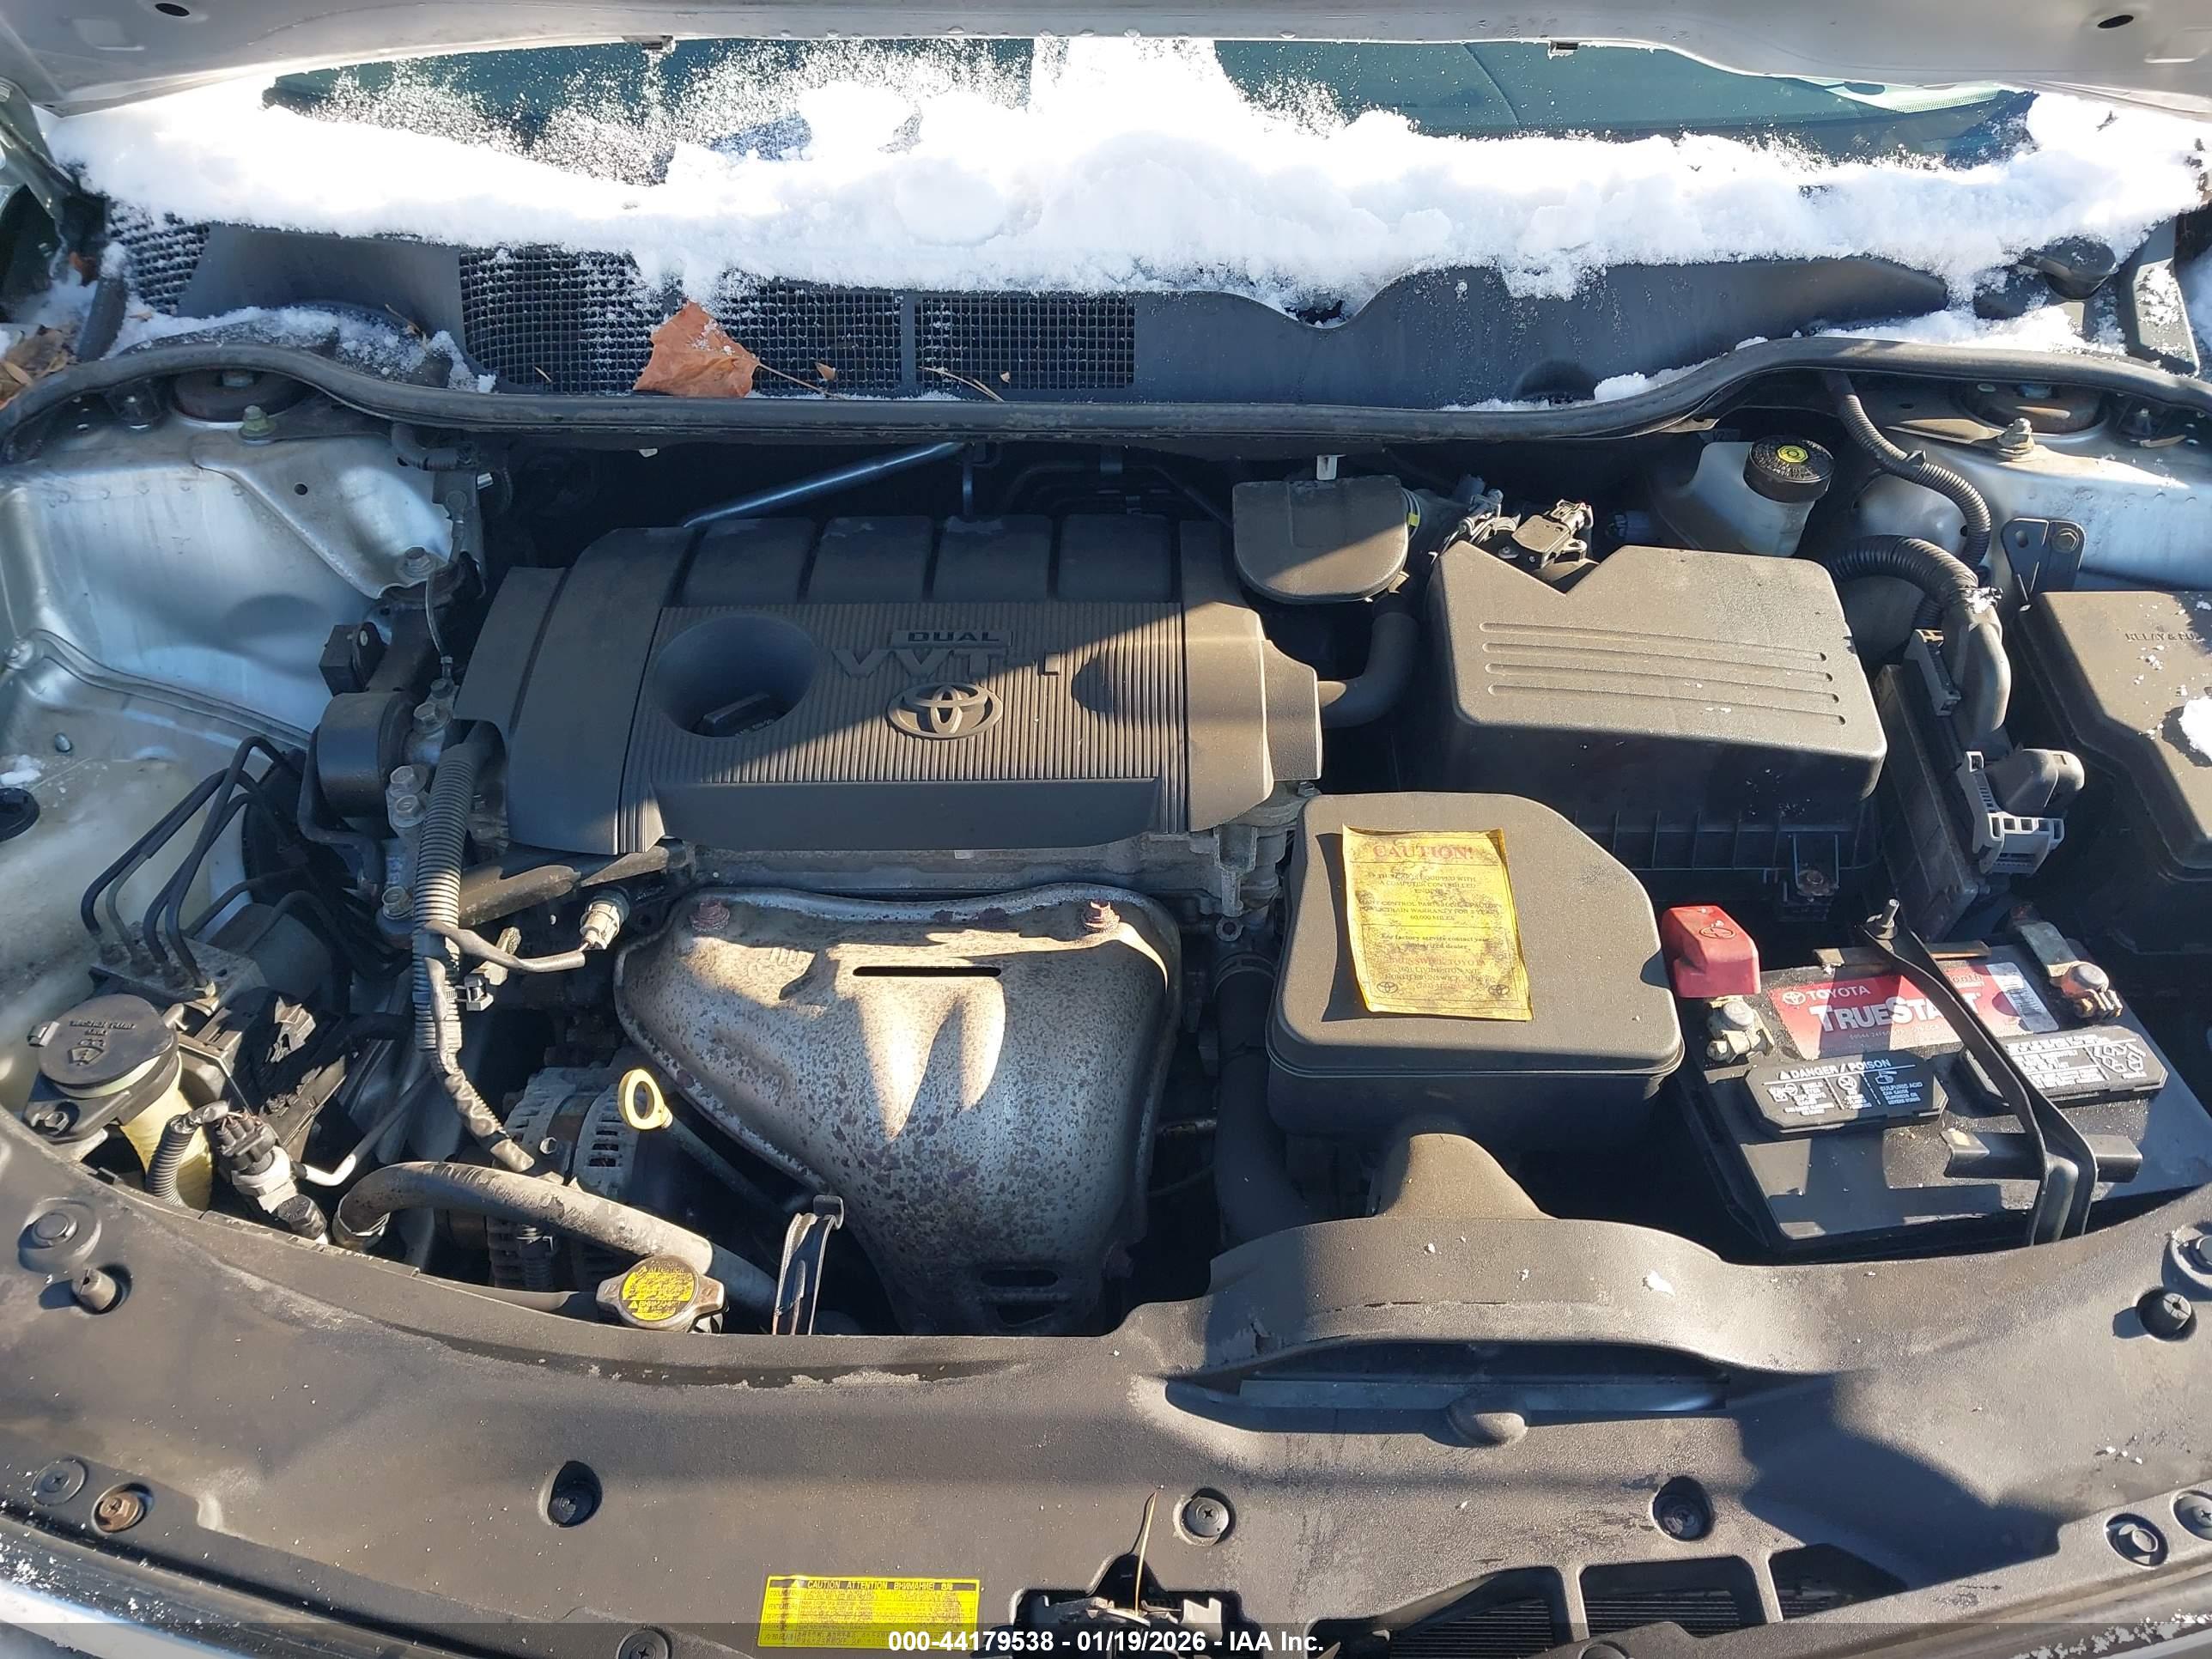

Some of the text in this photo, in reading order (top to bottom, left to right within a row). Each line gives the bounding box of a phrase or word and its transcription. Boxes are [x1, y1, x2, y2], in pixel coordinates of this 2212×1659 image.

[907, 631, 1000, 642] DUAL
[1372, 844, 1474, 860] CAUTION!
[1806, 985, 1872, 1001] TOYOTA
[1809, 993, 1980, 1032] TRUESTAT
[1790, 1065, 1837, 1079] DANGER
[1847, 1058, 1892, 1072] POISON
[806, 1580, 889, 1590] CAUTION ATTENTION
[893, 1582, 934, 1591] ВНИМАНИЕ
